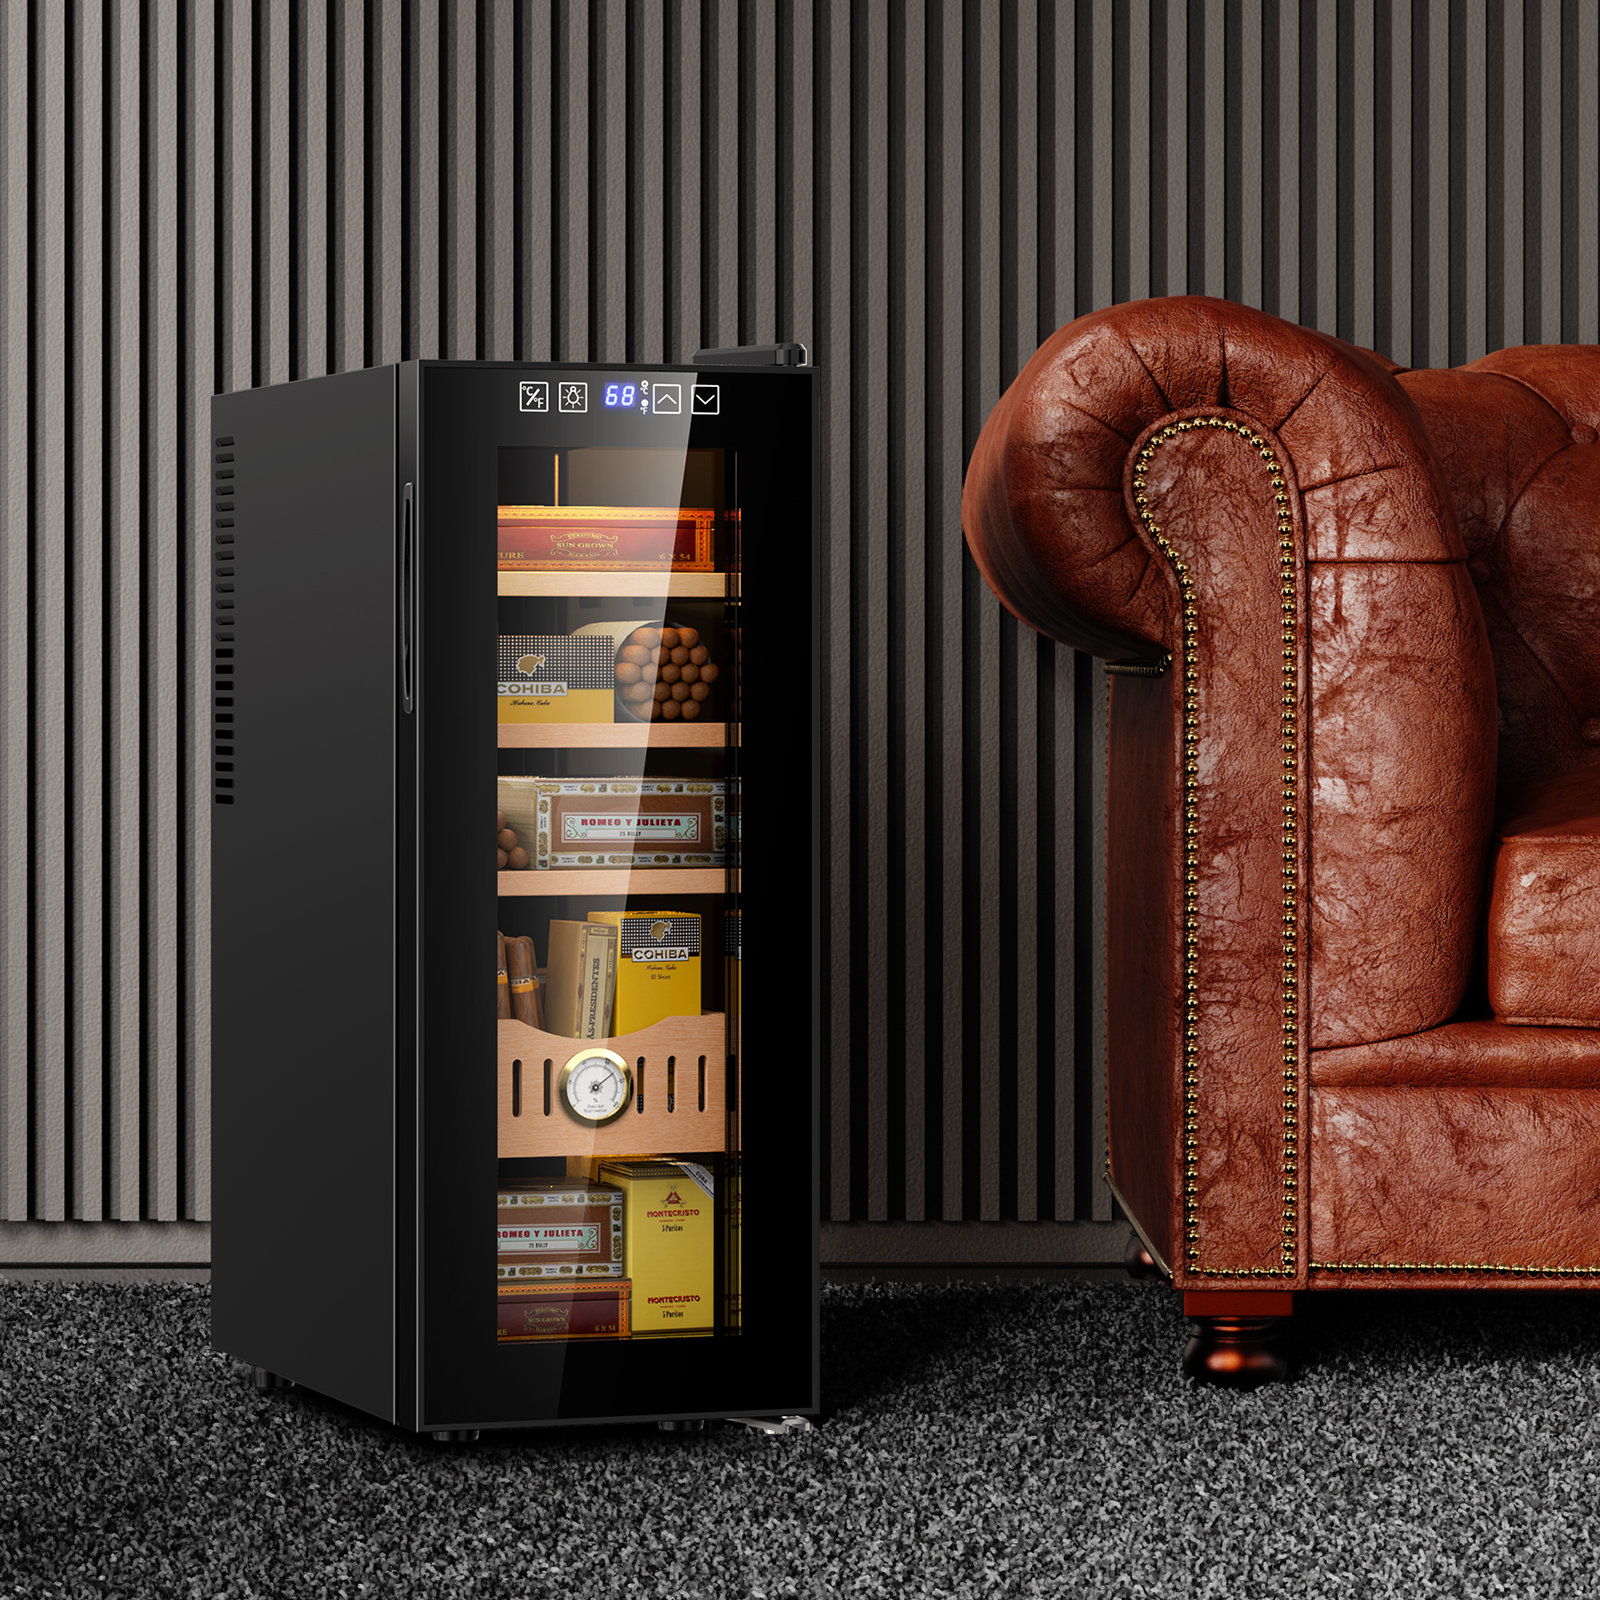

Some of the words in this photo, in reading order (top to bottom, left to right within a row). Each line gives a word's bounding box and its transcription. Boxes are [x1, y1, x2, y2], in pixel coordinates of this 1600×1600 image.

[604, 385, 636, 406] 68
[497, 684, 565, 694] COHIBA
[581, 818, 621, 827] ROMEO
[625, 818, 632, 827] Y
[636, 818, 682, 827] JULIETA
[633, 949, 688, 960] COHIBA
[646, 1209, 700, 1218] MONTECRISTO
[497, 1230, 531, 1239] ROMEO
[534, 1230, 541, 1238] Y
[544, 1229, 583, 1238] JULIETA
[647, 1295, 701, 1304] MONTECRISTO
